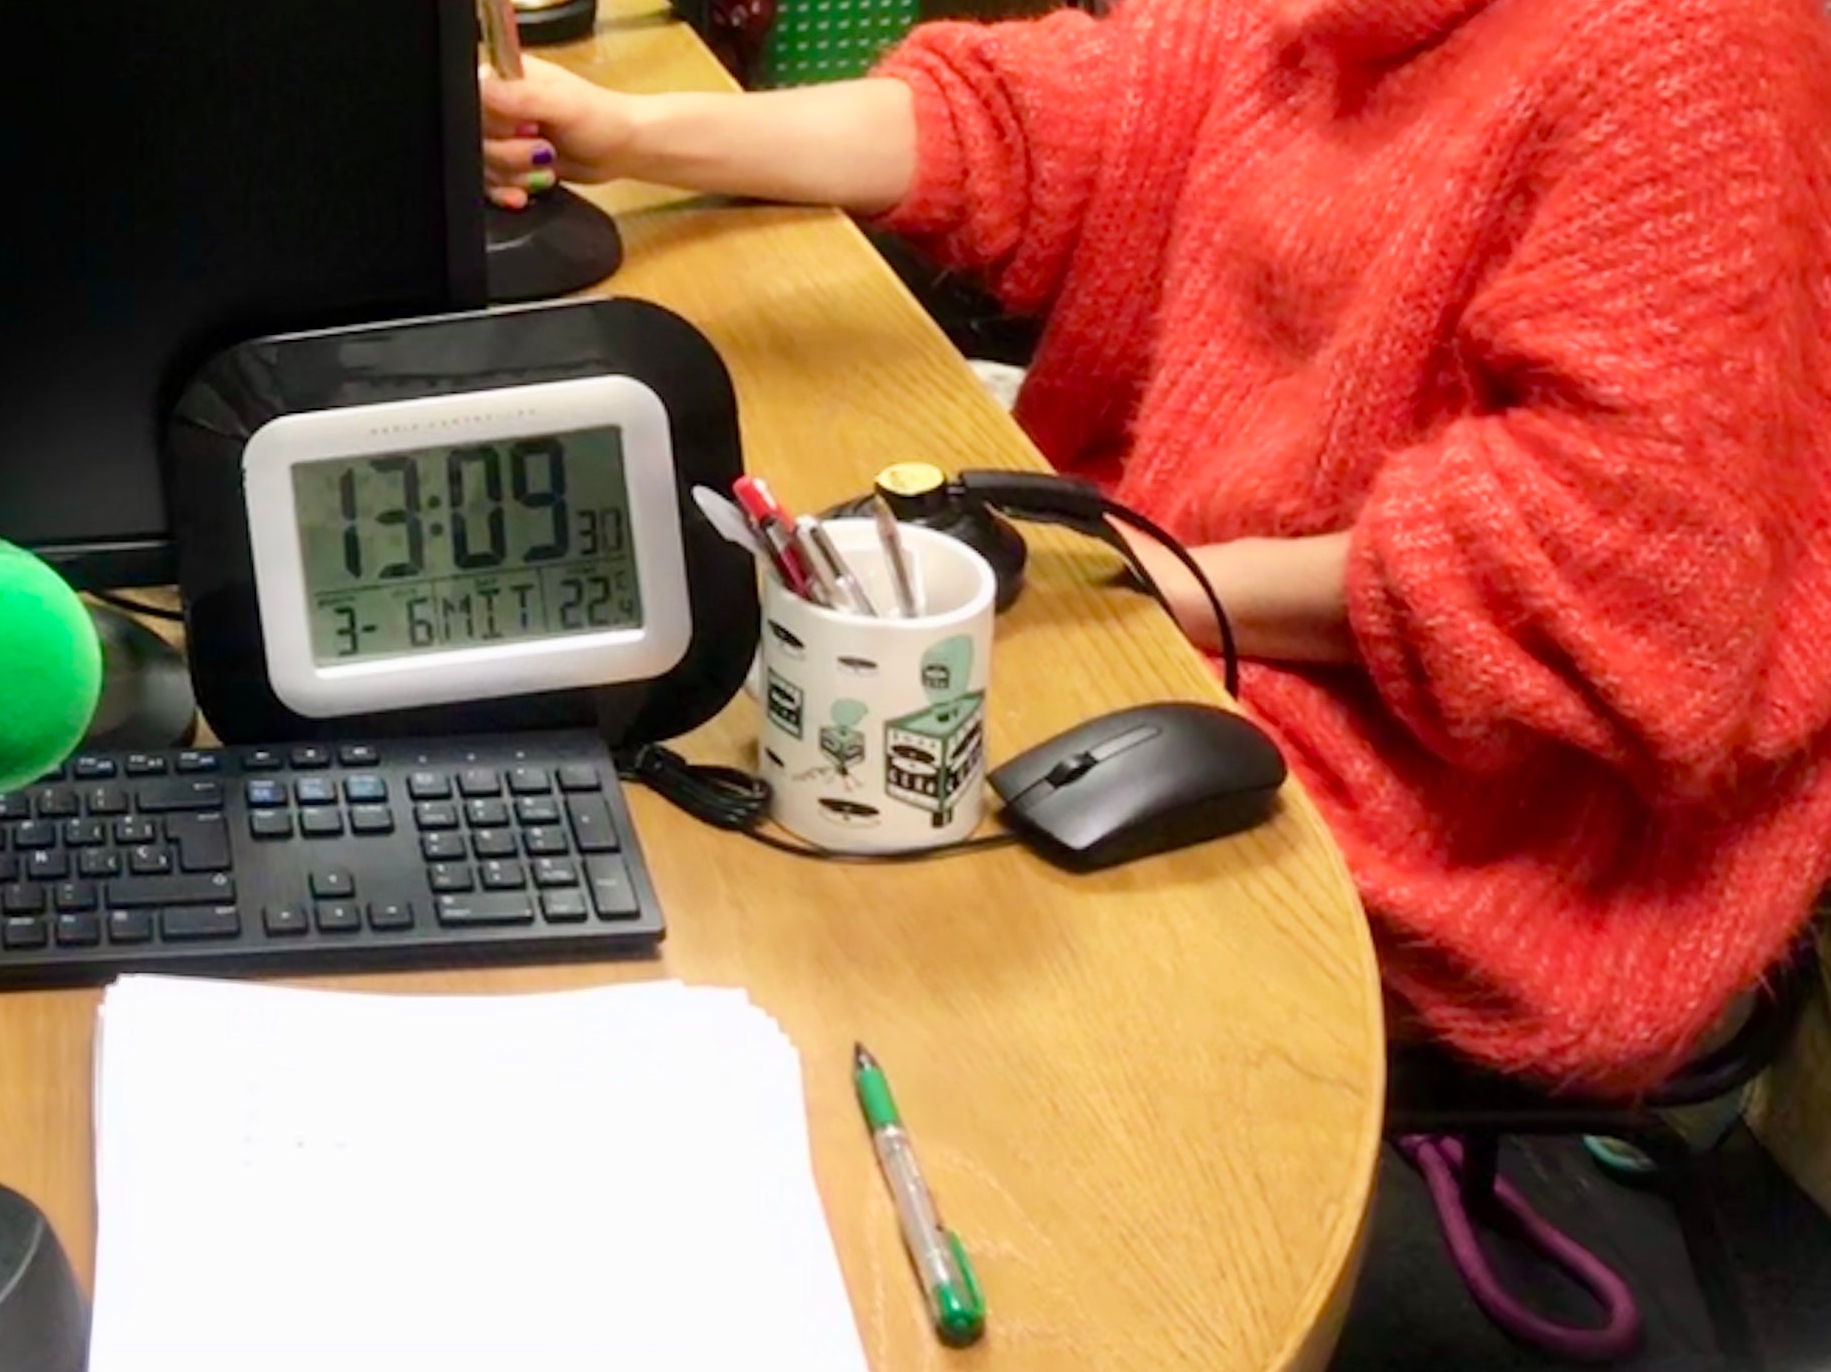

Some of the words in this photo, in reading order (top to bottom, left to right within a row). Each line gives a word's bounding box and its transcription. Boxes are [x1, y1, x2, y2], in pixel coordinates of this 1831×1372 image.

[338, 439, 570, 579] 13:09
[577, 507, 623, 557] 30
[406, 597, 435, 648] 6
